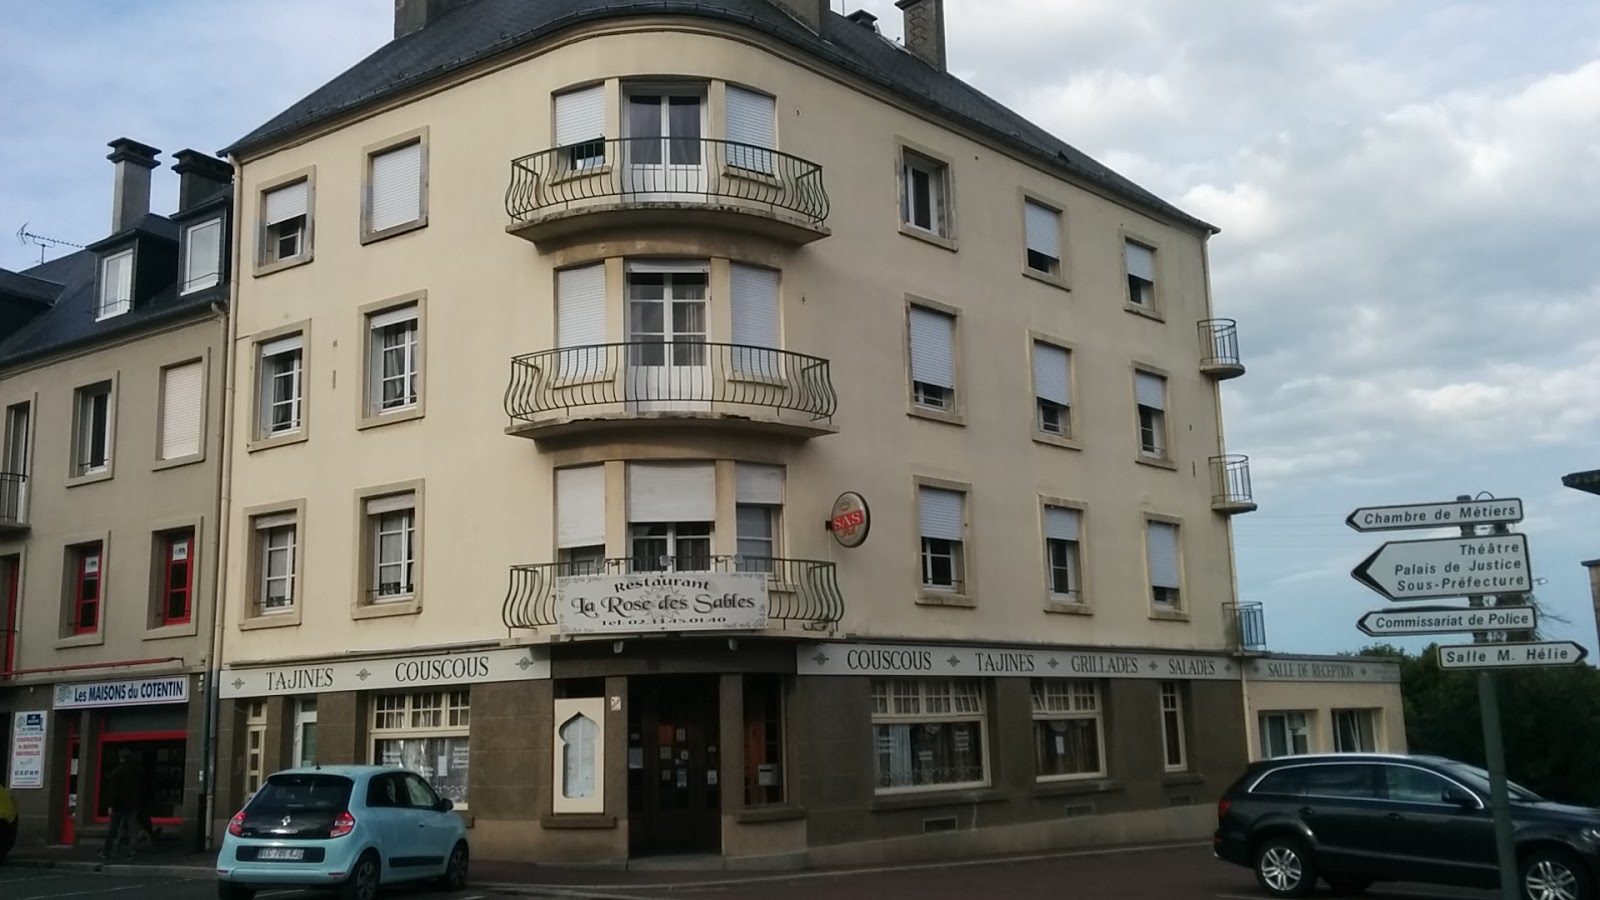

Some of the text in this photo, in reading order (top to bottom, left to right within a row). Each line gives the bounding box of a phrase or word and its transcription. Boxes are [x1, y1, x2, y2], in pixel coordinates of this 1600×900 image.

[1364, 505, 1516, 525] Chambre de Métiers
[1460, 543, 1519, 556] Théâtre
[1394, 559, 1522, 576] Palais de Justice
[614, 577, 711, 593] Restaurant
[1396, 574, 1525, 592] Sous-Préfecture
[570, 592, 756, 618] La Rose des Sables
[1375, 611, 1529, 629] Commissariat de Police
[847, 650, 932, 670] COUSCOUS
[975, 652, 1035, 672] TAJINES
[1446, 646, 1569, 663] Salle M. Hélie
[395, 656, 489, 682] COUSCOUS
[1071, 655, 1138, 673] GRILLADES
[1168, 659, 1216, 675] SALADES
[266, 668, 334, 691] TAJINES
[74, 680, 183, 702] Les MAISONS du COTENTIN
